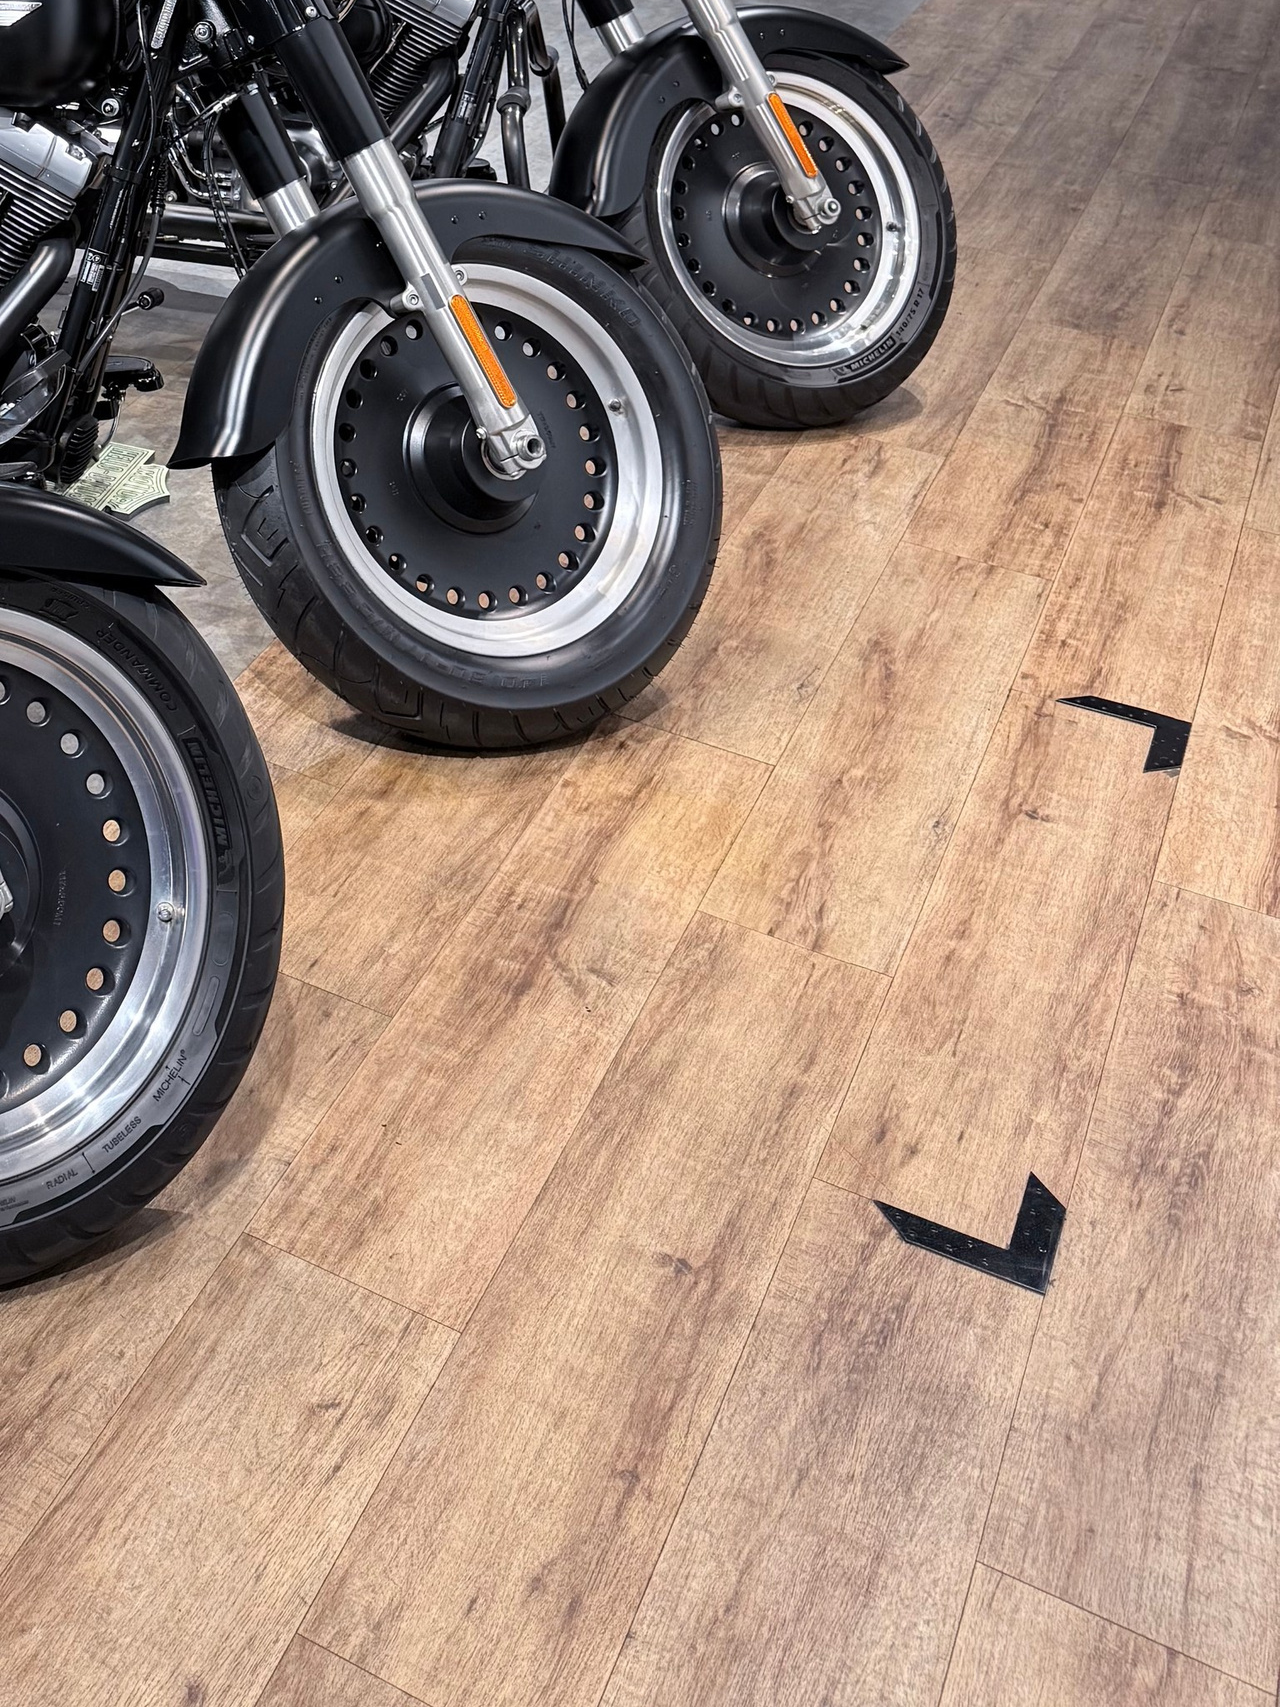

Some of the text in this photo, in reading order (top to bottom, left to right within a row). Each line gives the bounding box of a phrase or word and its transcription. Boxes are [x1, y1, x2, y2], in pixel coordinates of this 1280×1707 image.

[850, 336, 895, 371] MICHELIN
[95, 628, 178, 712] COMMANDER
[186, 741, 230, 845] MICHELIN
[45, 1115, 142, 1190] RADIAL TUBELESS
